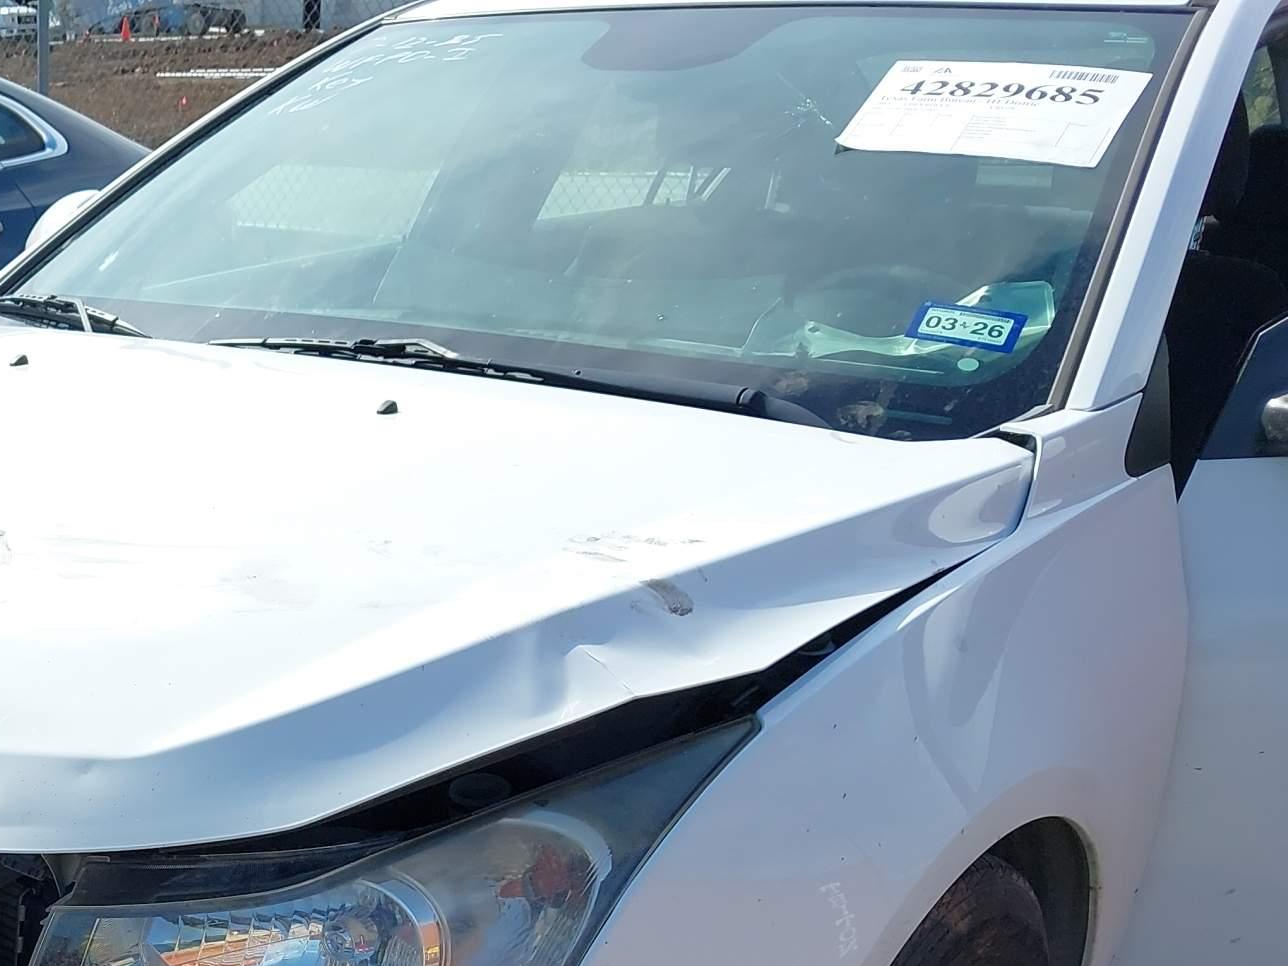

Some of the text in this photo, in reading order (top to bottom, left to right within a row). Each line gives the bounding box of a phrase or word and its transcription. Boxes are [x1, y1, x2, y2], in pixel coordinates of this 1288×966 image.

[900, 79, 1105, 105] 42829685
[925, 314, 959, 331] 03
[969, 321, 1006, 339] 26
